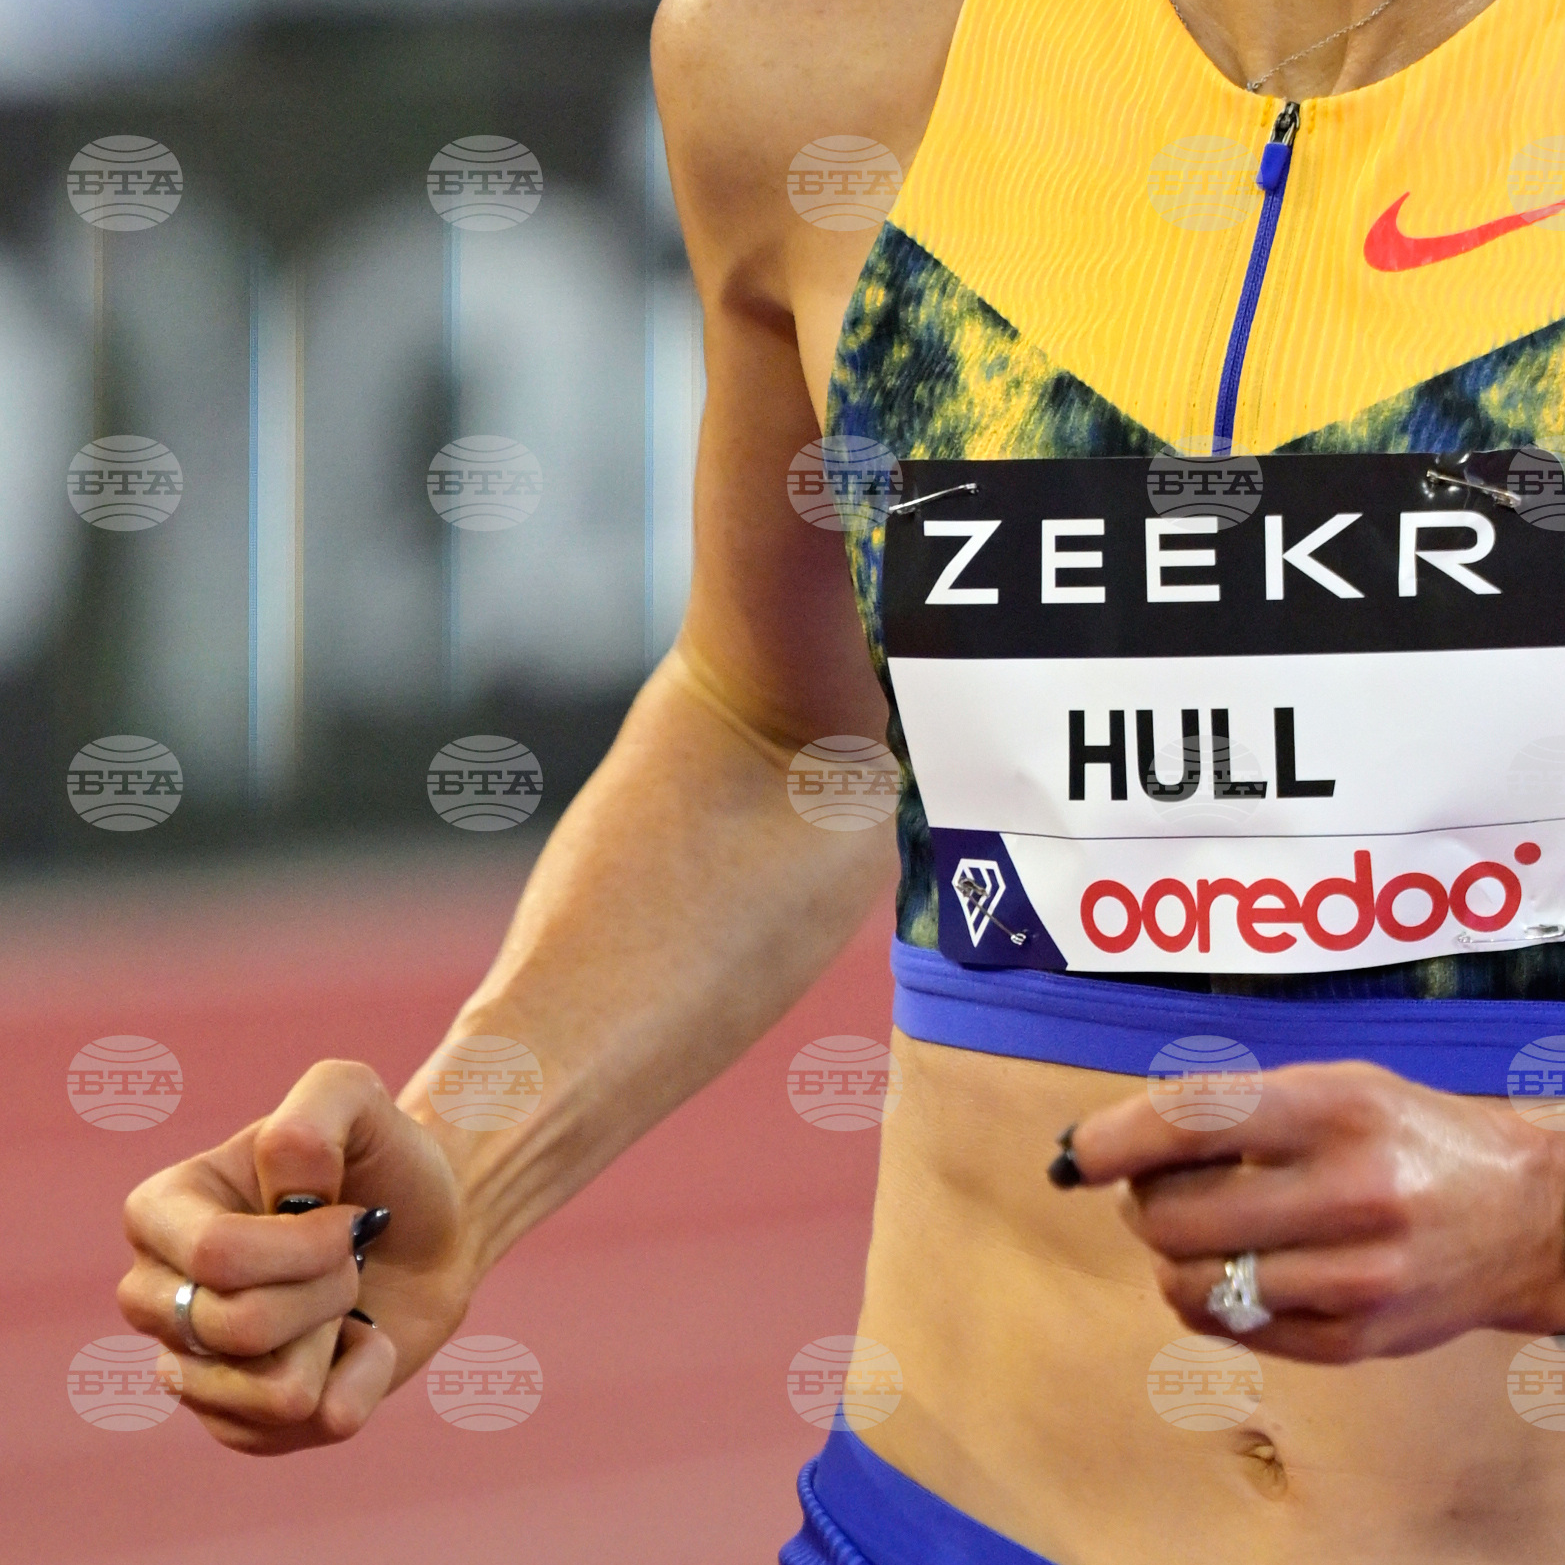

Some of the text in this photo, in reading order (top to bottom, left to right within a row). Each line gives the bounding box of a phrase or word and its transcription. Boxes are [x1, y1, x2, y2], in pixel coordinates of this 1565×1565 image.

[922, 510, 1502, 605] ZEEKR
[1068, 706, 1336, 801] HULL
[1080, 849, 1523, 954] ooredoo
